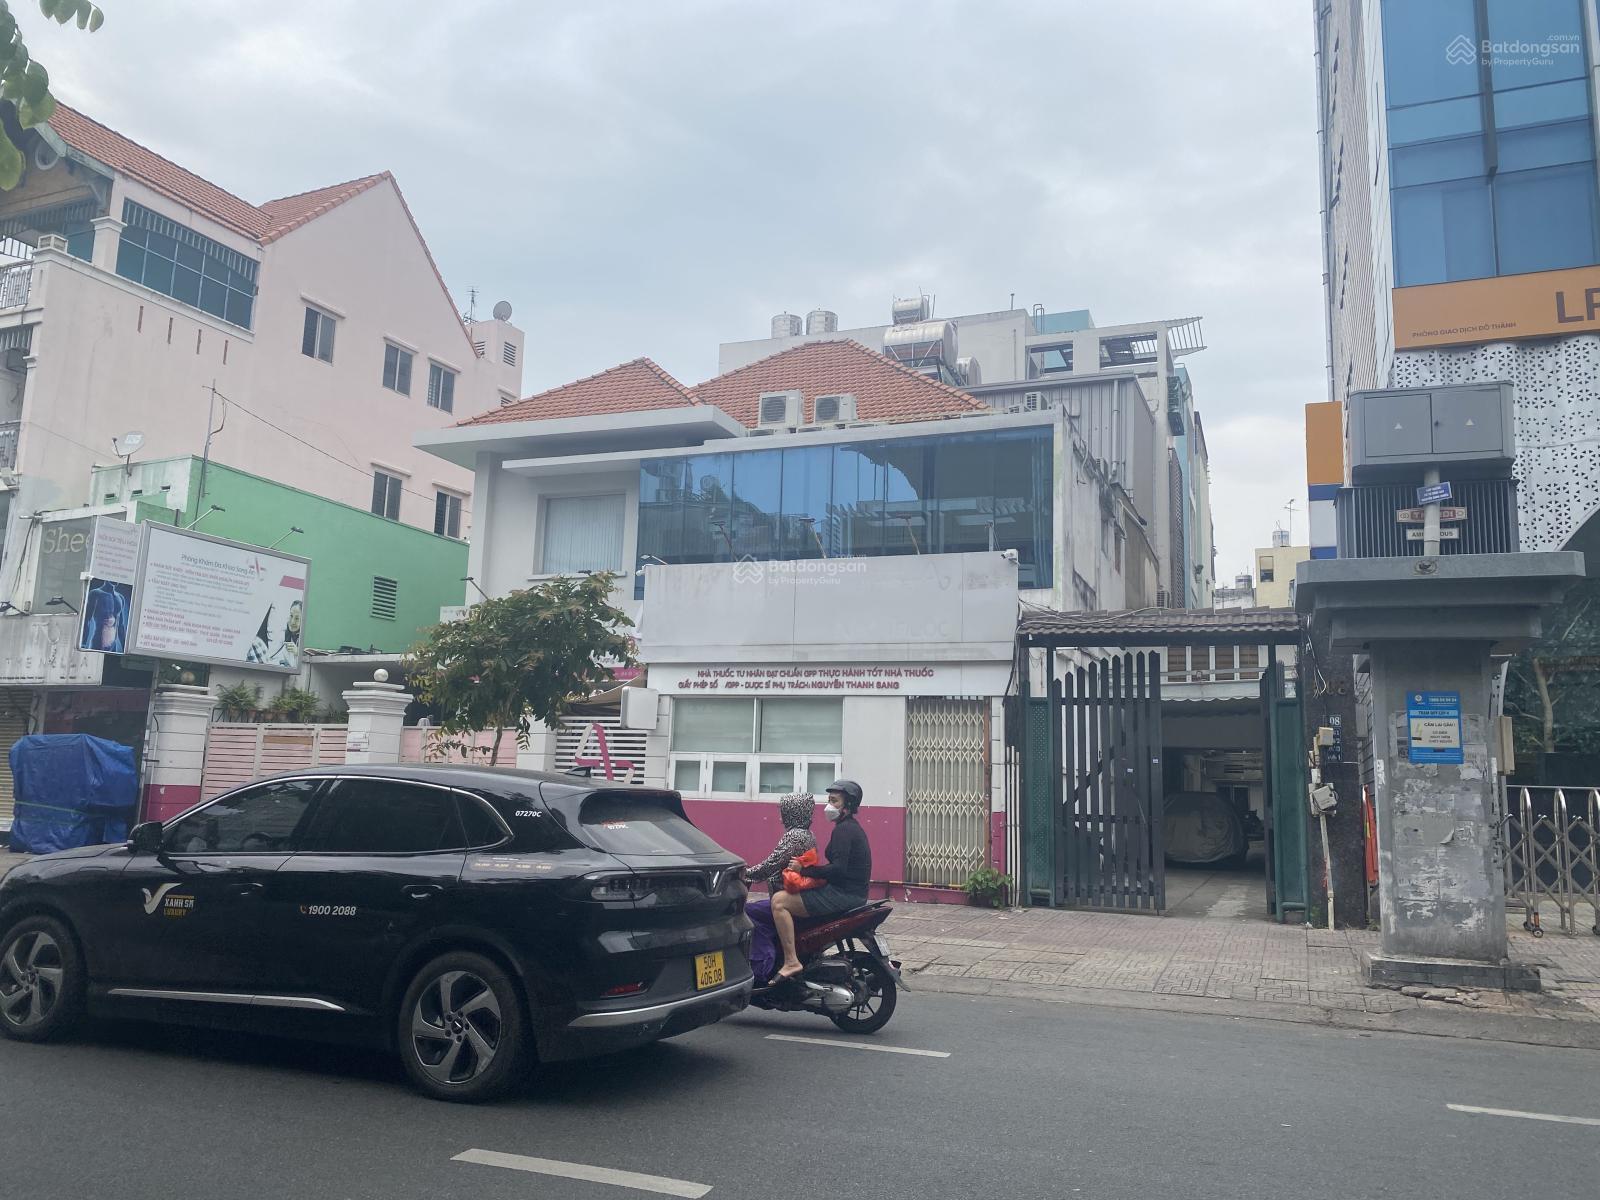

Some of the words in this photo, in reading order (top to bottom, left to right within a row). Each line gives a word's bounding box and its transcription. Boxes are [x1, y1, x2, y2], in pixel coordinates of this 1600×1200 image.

[1412, 330, 1439, 338] PHÒNG
[1440, 328, 1459, 336] GIAO
[1460, 326, 1478, 335] DỊCH
[698, 668, 712, 678] NHÀ
[713, 668, 734, 678] THUỐC
[818, 669, 840, 679] THỰC
[842, 668, 865, 677] HÀNH
[884, 668, 902, 677] NHÀ
[904, 666, 934, 677] THUỐC
[693, 679, 708, 689] PHÉP
[811, 679, 844, 689] NGUYỄN
[846, 681, 874, 689] THANH
[876, 681, 900, 690] SANG
[164, 898, 183, 908] XANH
[308, 905, 330, 915] 1900
[332, 906, 356, 916] 2088
[704, 954, 716, 970] 50H
[700, 968, 722, 986] 406.08
